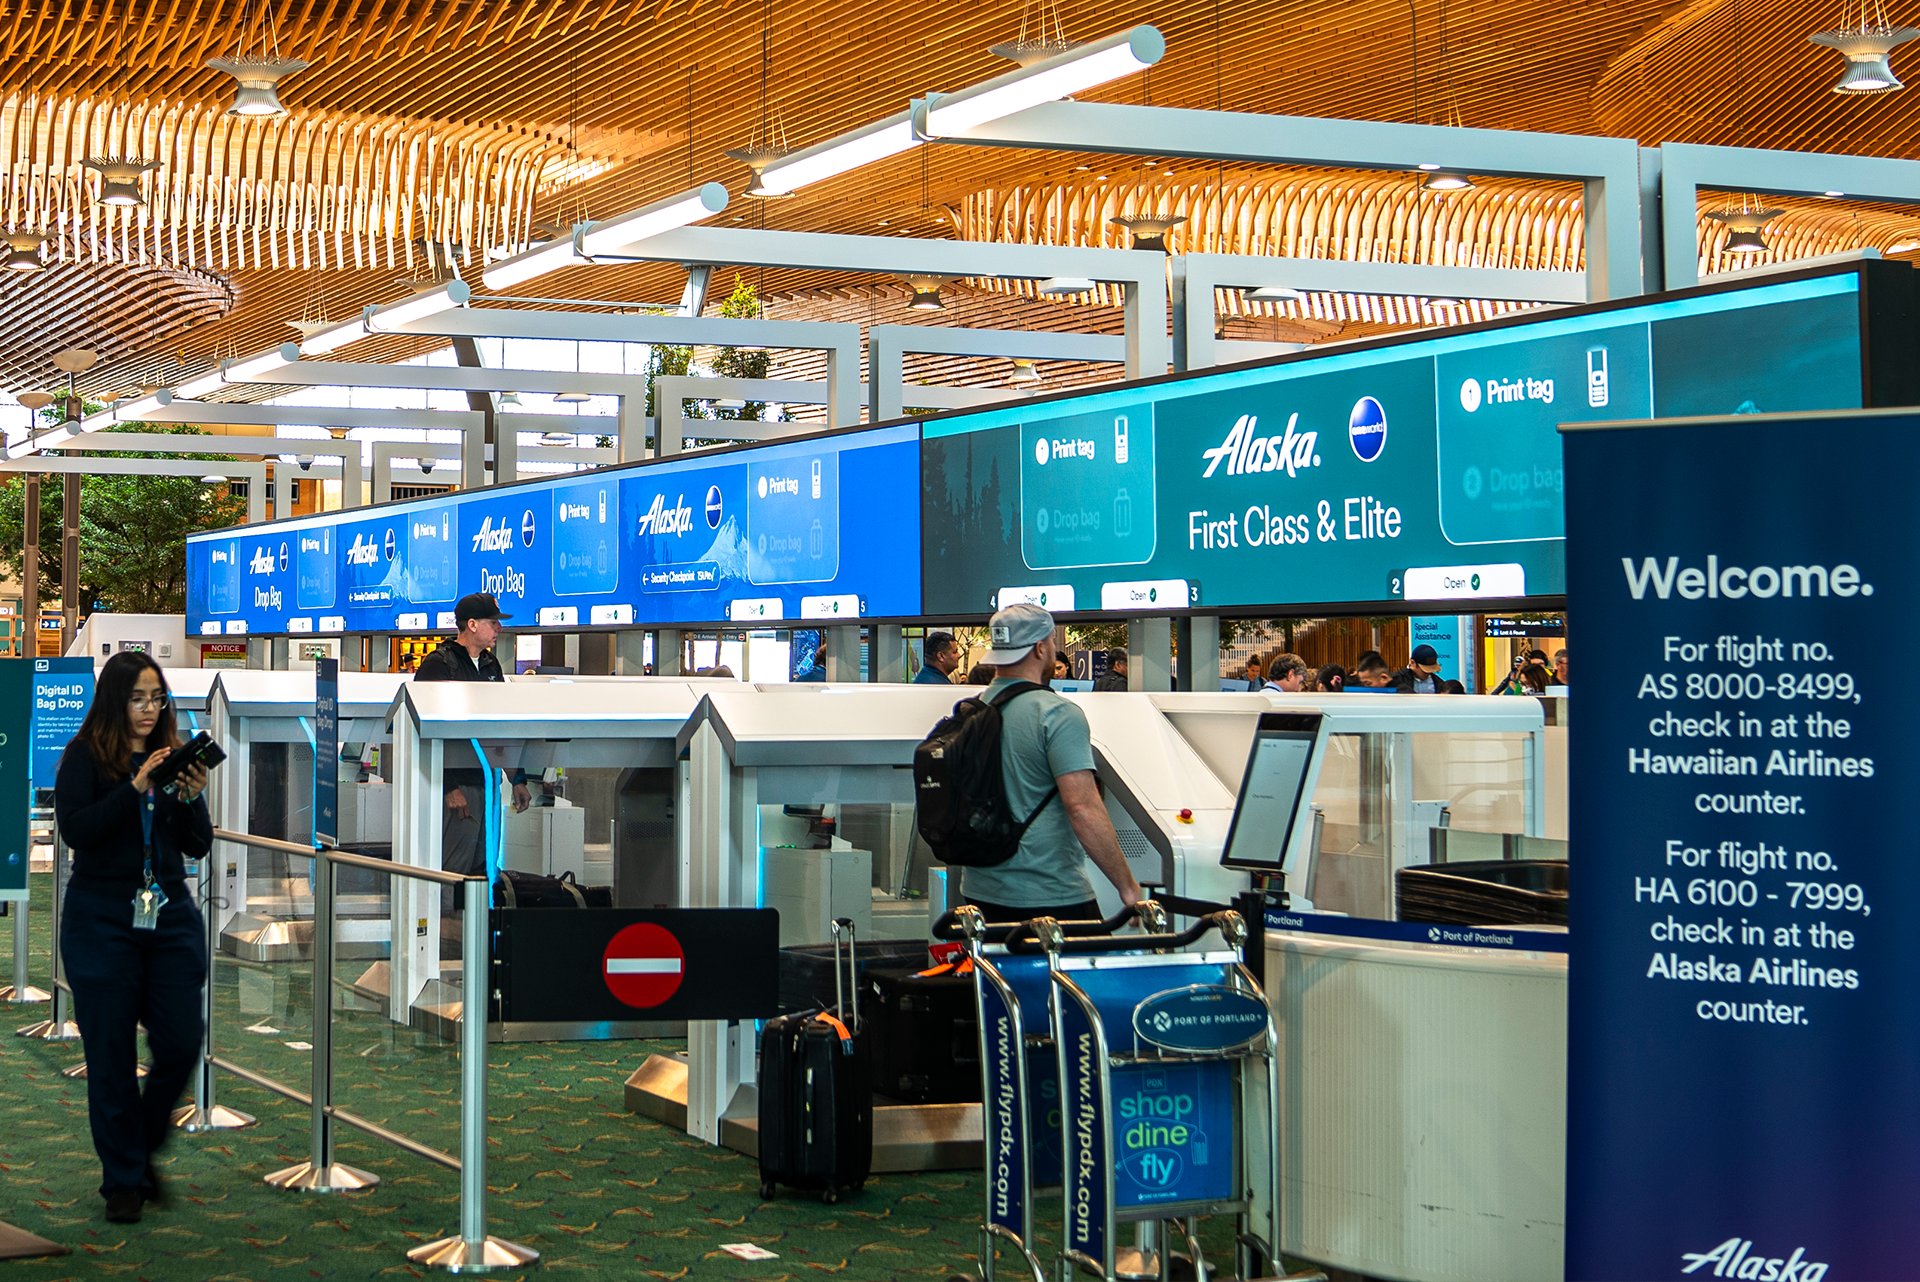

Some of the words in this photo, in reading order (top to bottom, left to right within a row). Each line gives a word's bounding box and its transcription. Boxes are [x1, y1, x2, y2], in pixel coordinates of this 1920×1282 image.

[1486, 378, 1523, 405] Print
[1527, 377, 1554, 404] tag
[1052, 438, 1076, 460] Print
[1077, 440, 1095, 460] tag
[769, 478, 785, 494] Print
[786, 478, 798, 496] tag
[1490, 468, 1529, 496] Drop
[1534, 464, 1562, 493] bag
[568, 504, 580, 518] Print
[580, 506, 590, 520] tag
[1054, 510, 1078, 531] Drop
[1081, 507, 1100, 530] bag
[1188, 510, 1238, 550] First
[1244, 504, 1310, 546] Class
[1316, 499, 1336, 542] &
[1344, 496, 1402, 540] Elite
[770, 535, 787, 554] Drop
[788, 534, 801, 554] bag
[481, 568, 504, 600] Drop
[506, 566, 524, 599] Bag
[1392, 578, 1400, 594] 2
[1444, 577, 1466, 591] Open
[1622, 554, 1874, 600] Welcome.
[255, 586, 270, 612] Drop
[270, 586, 282, 612] Bag
[860, 600, 866, 612] 5
[990, 596, 996, 608] 4
[1130, 590, 1146, 602] Open
[1190, 587, 1198, 602] 3
[725, 606, 730, 616] 6
[1414, 622, 1438, 632] Special
[1664, 636, 1709, 661] For
[1715, 635, 1784, 668] flight
[1792, 642, 1834, 661] no.
[37, 685, 69, 698] Digital
[72, 685, 83, 695] ID
[1638, 673, 1678, 700] AS
[1686, 673, 1861, 705] 8000-8499,
[37, 698, 56, 710] Bag
[58, 698, 84, 710] Drop
[1649, 711, 1731, 737] check
[1739, 711, 1762, 737] in
[1770, 714, 1798, 738] at
[1806, 712, 1851, 738] the
[1628, 748, 1757, 775] Hawaiian
[1765, 749, 1874, 777] Airlines
[1695, 790, 1805, 815] counter.
[1666, 840, 1711, 867] For
[1717, 841, 1787, 875] flight
[1796, 850, 1838, 872] no.
[1635, 876, 1680, 904] HA
[1687, 878, 1758, 907] 6100
[1786, 881, 1870, 916] 7999,
[1268, 914, 1303, 927] Portland
[1650, 915, 1733, 944] check
[1741, 918, 1764, 945] in
[1773, 922, 1801, 947] at
[1808, 921, 1854, 950] the
[1444, 931, 1462, 942] Port
[1463, 932, 1474, 943] of
[1475, 933, 1513, 944] Portland
[1646, 952, 1741, 983] Alaska
[1748, 957, 1859, 989] Airlines
[1174, 1016, 1197, 1025] PORT
[1200, 1016, 1211, 1024] OF
[1214, 1014, 1255, 1024] PORTLAND
[1696, 999, 1808, 1025] counter.
[1146, 1078, 1162, 1087] PDX
[997, 1017, 1015, 1218] www.flypdx.com
[1120, 1091, 1192, 1120] shop
[1077, 1033, 1096, 1243] www.flypdx.com
[1126, 1122, 1188, 1148] dine
[1140, 1153, 1175, 1185] fly
